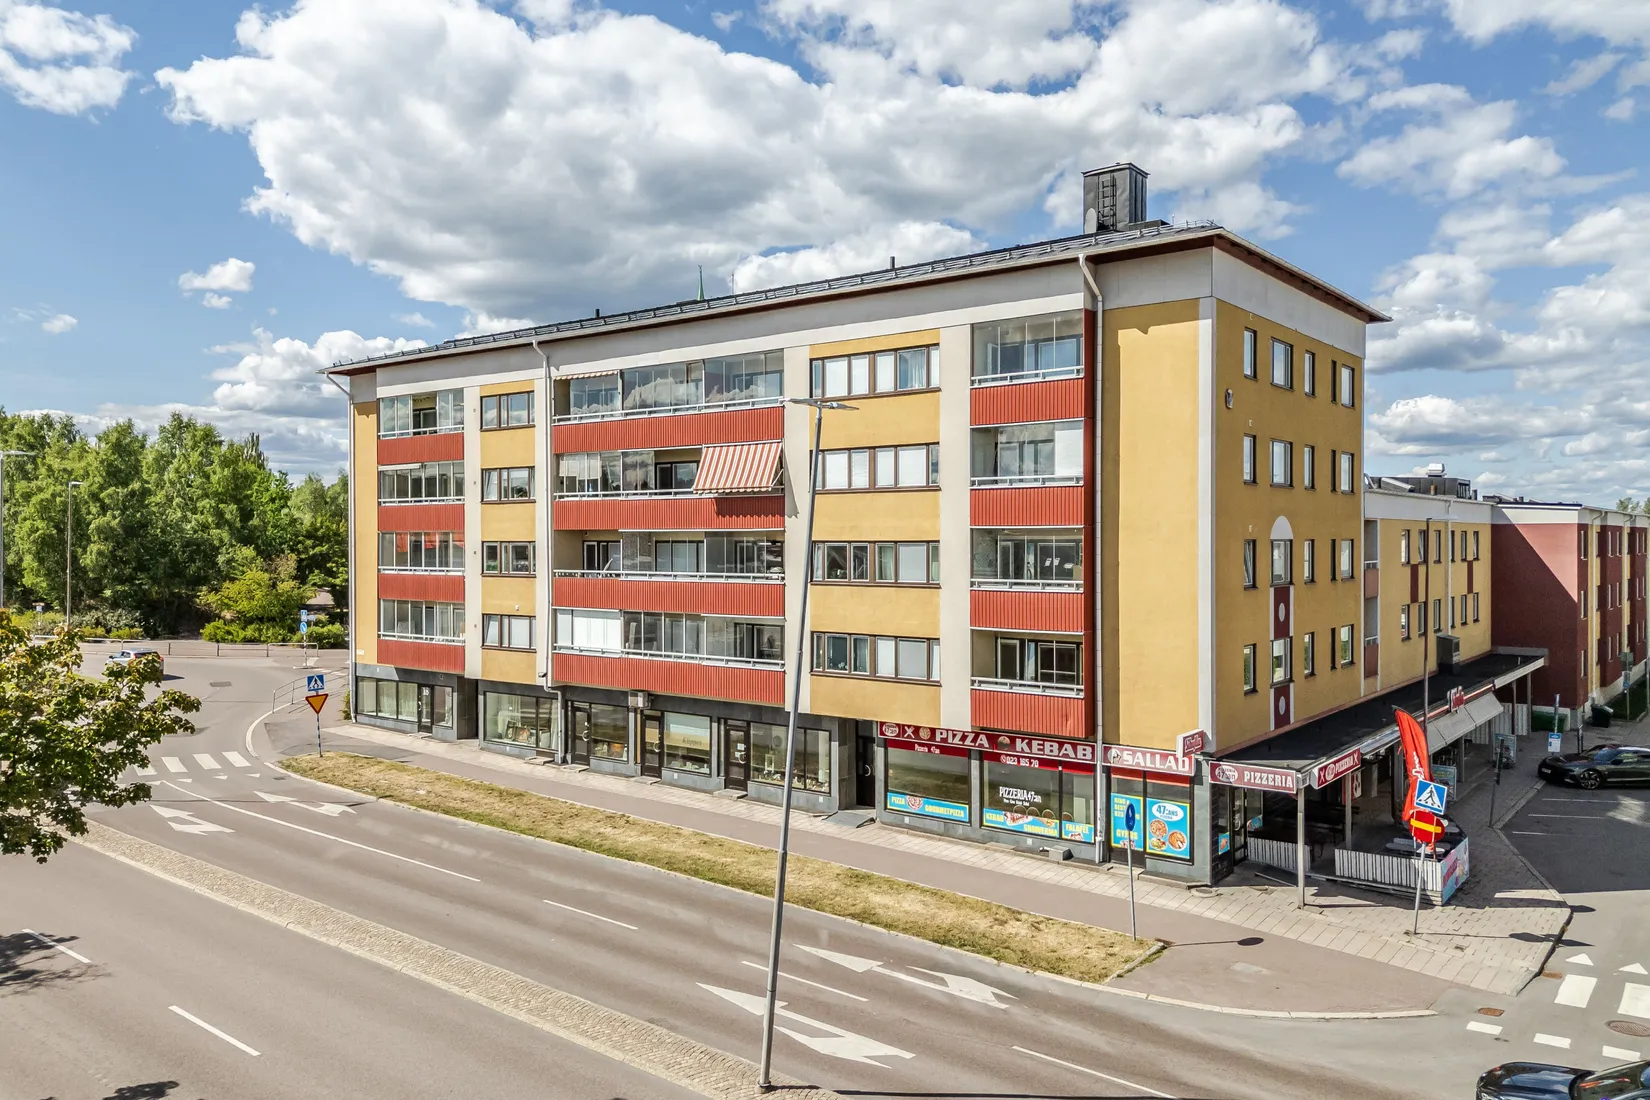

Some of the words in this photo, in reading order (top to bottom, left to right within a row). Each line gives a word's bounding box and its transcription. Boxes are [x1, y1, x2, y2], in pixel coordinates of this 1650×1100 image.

[935, 728, 989, 748] PIZZA
[1015, 738, 1092, 760] KEBAB
[1006, 756, 1018, 765] 023
[1031, 759, 1039, 768] 70
[1122, 750, 1190, 772] SALLAD
[1243, 770, 1293, 788] PIZZERIA
[891, 796, 905, 805] PIZZA
[999, 786, 1028, 801] PIZZERIA
[1065, 823, 1089, 834] FALAFEL
